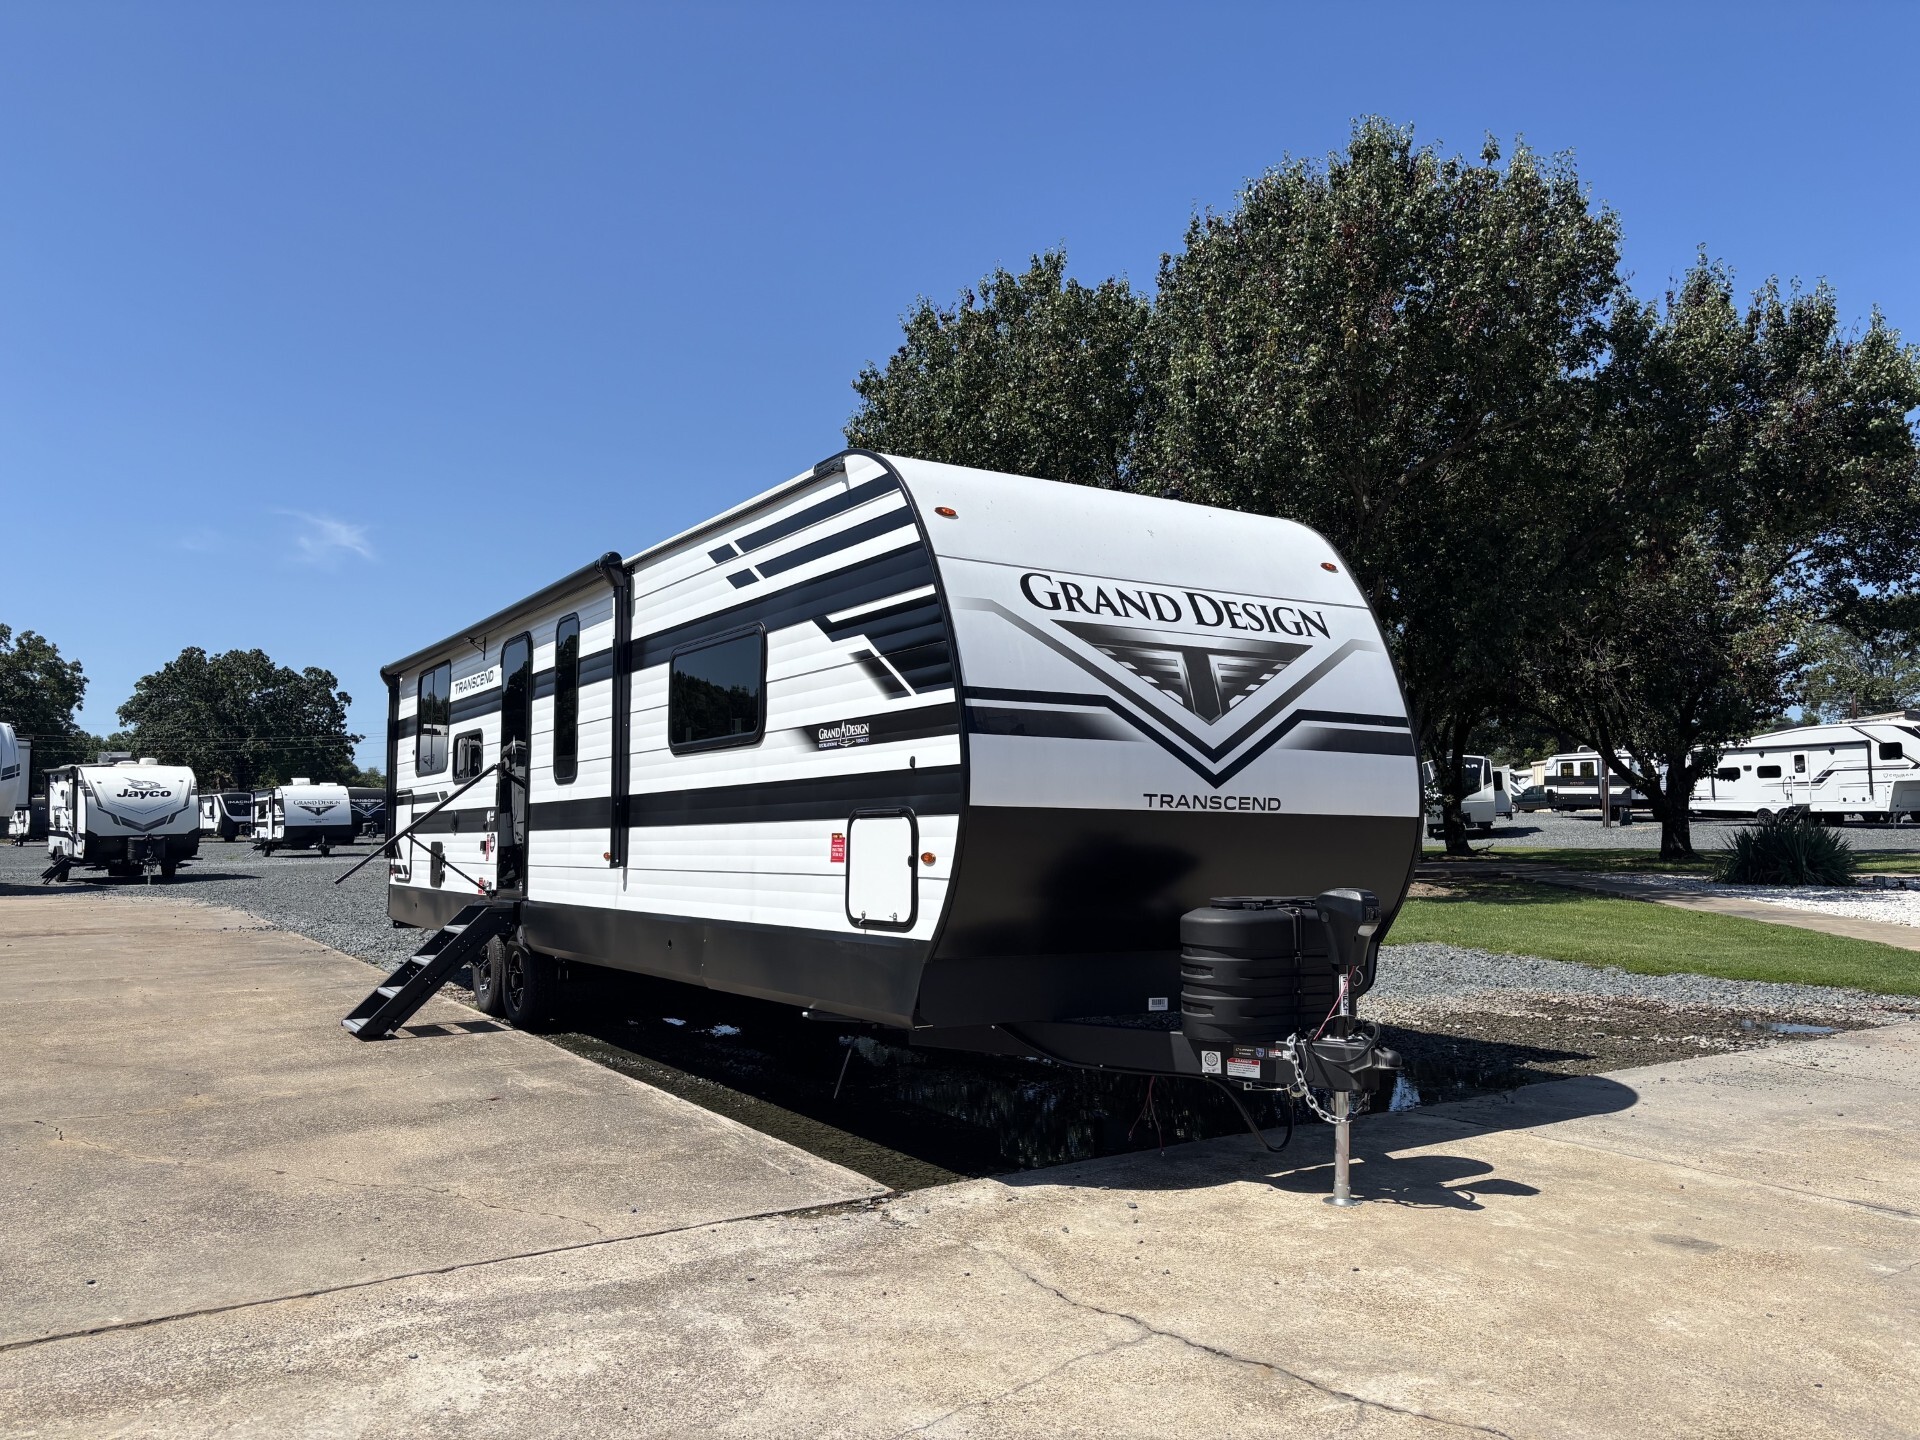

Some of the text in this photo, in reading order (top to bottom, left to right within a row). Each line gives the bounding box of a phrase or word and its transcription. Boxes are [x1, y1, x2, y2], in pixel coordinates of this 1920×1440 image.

[1019, 572, 1331, 640] GRAND DESIGN
[455, 670, 494, 694] TRANSCEND
[818, 723, 869, 740] GRAND DESIGN
[116, 788, 171, 799] Jayco
[1142, 793, 1281, 811] TRANSCEND
